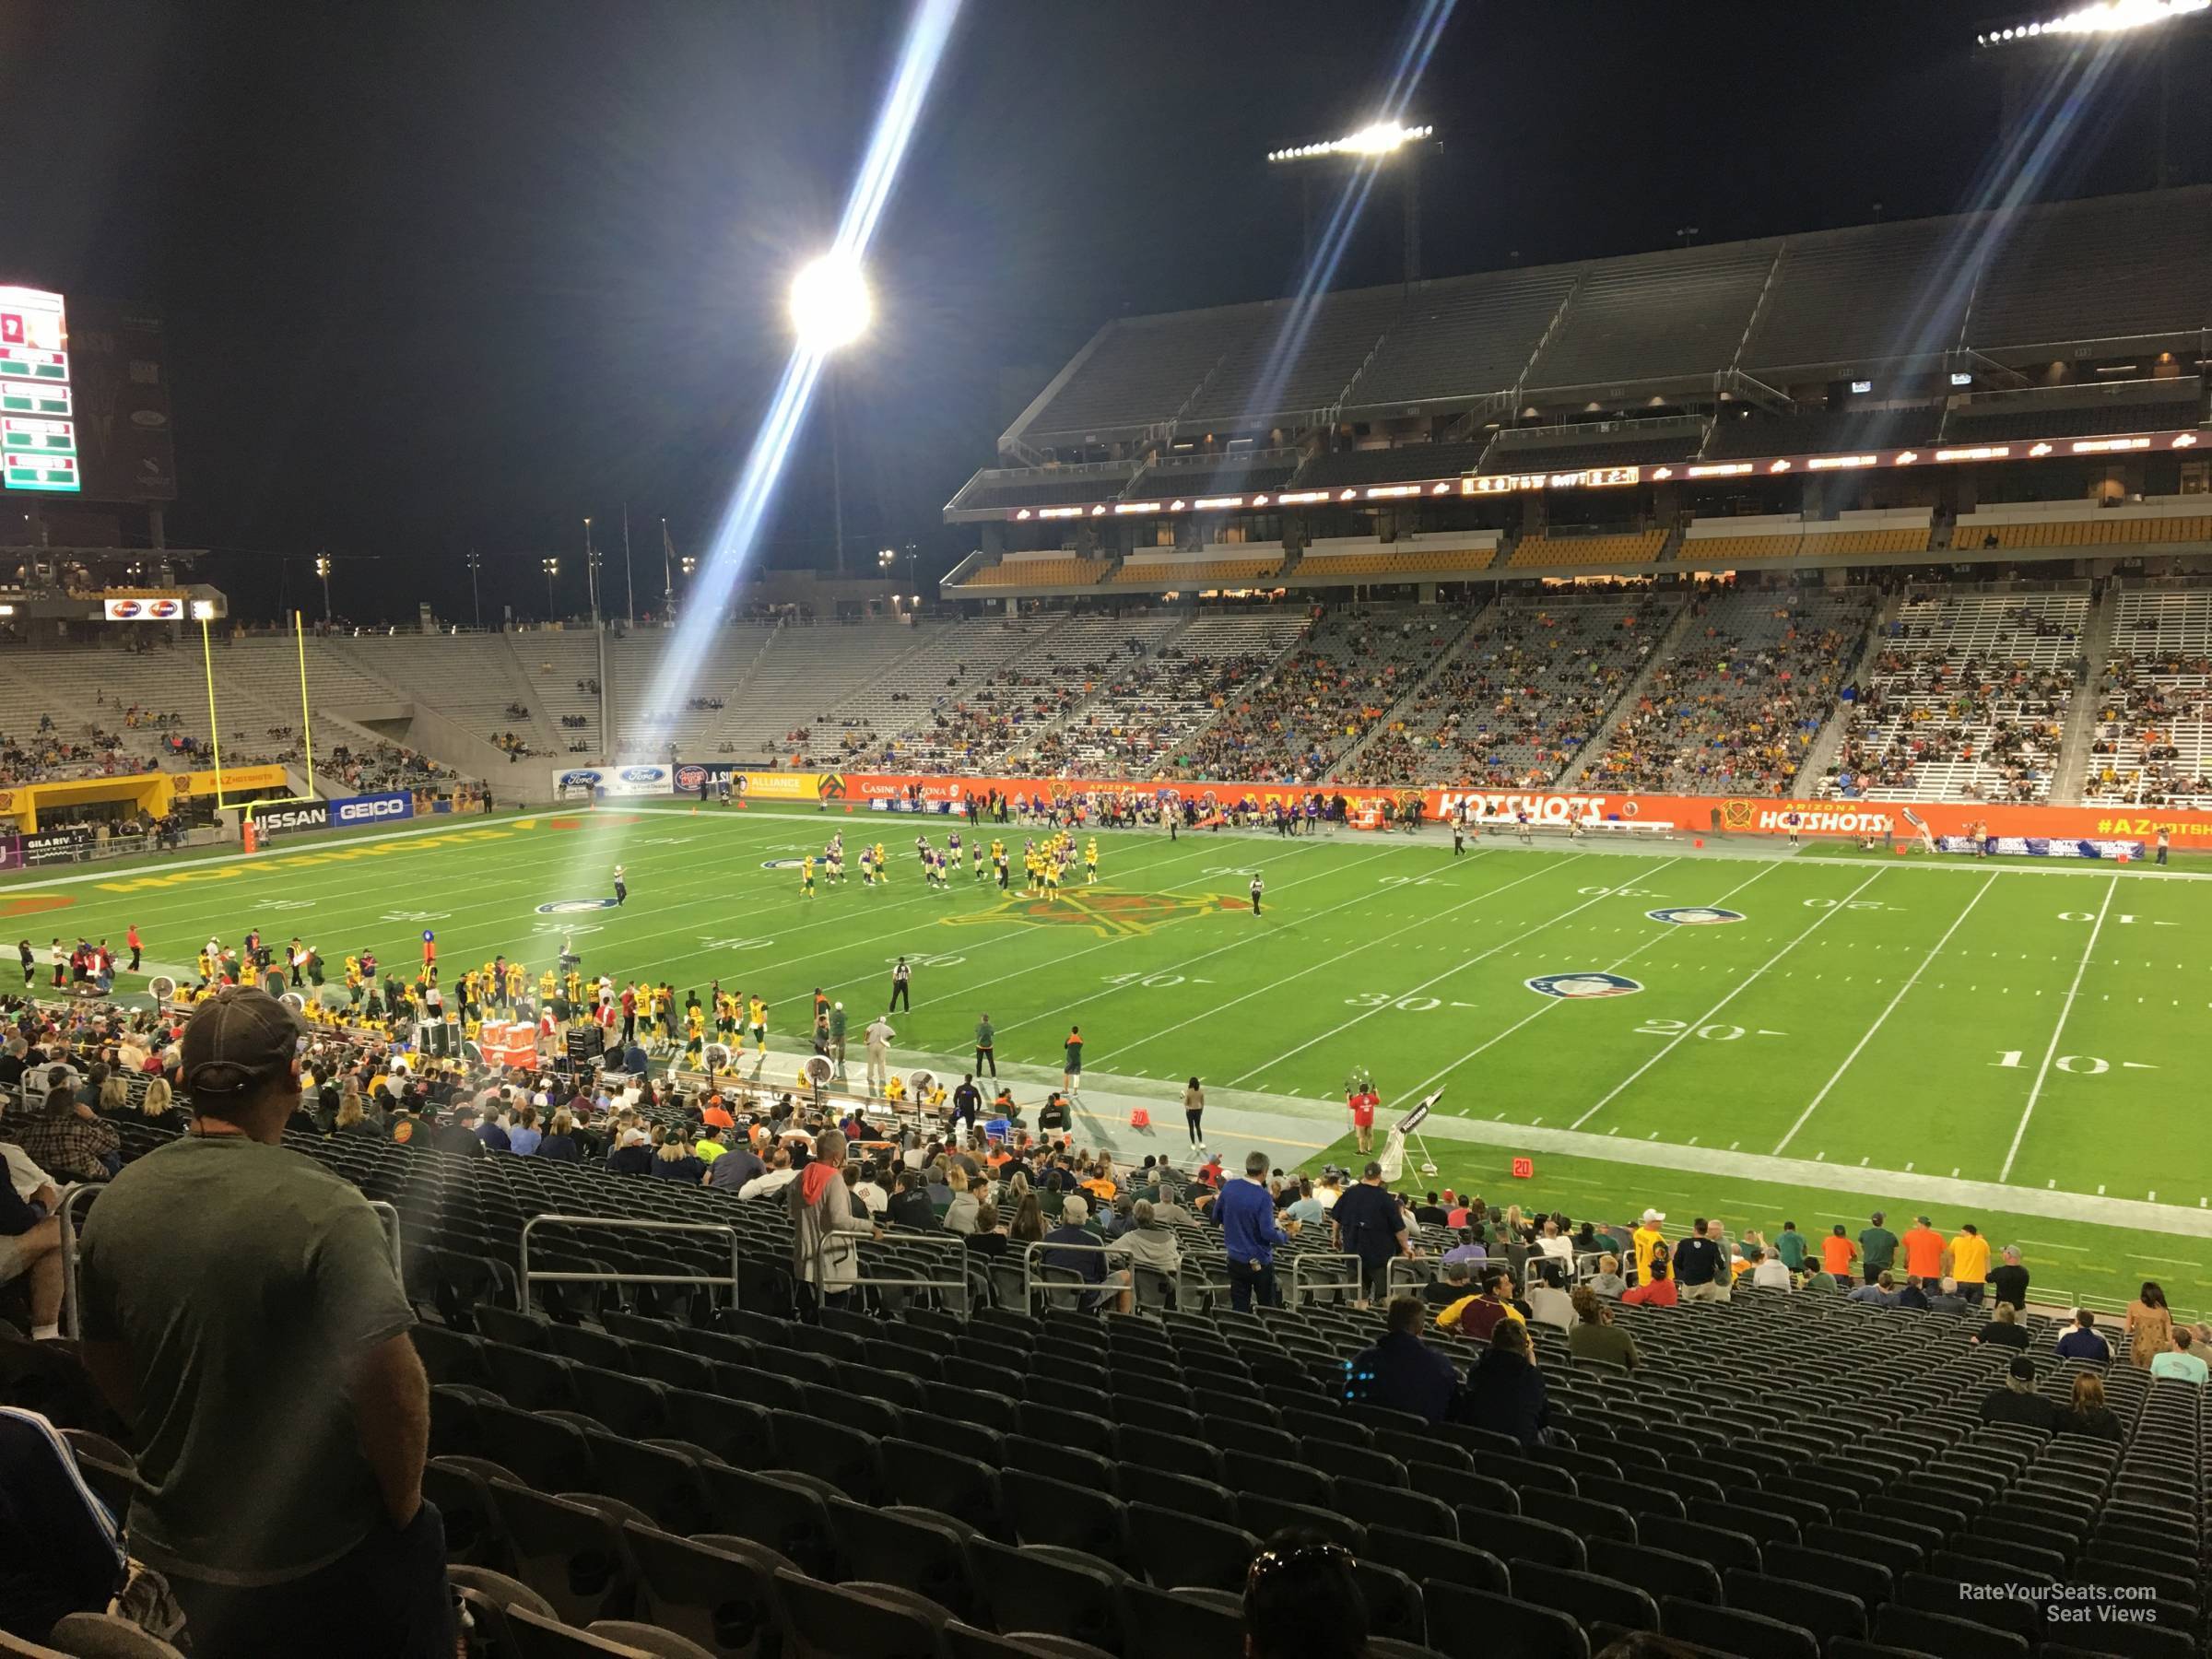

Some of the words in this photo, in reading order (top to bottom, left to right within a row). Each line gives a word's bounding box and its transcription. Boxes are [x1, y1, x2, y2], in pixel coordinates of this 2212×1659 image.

[568, 772, 594, 785] Ford
[629, 767, 655, 781] Ford
[752, 778, 801, 788] ALLIANCE
[901, 783, 946, 795] AZONA
[340, 799, 404, 819] GEICO
[1785, 803, 1856, 811] ARIZONA
[28, 839, 52, 848] GILA
[1344, 993, 1441, 1011] 30
[1633, 1018, 1746, 1041] 20
[1988, 1050, 2111, 1075] 10
[1133, 1111, 1145, 1124] 30
[1514, 1159, 1530, 1175] 20
